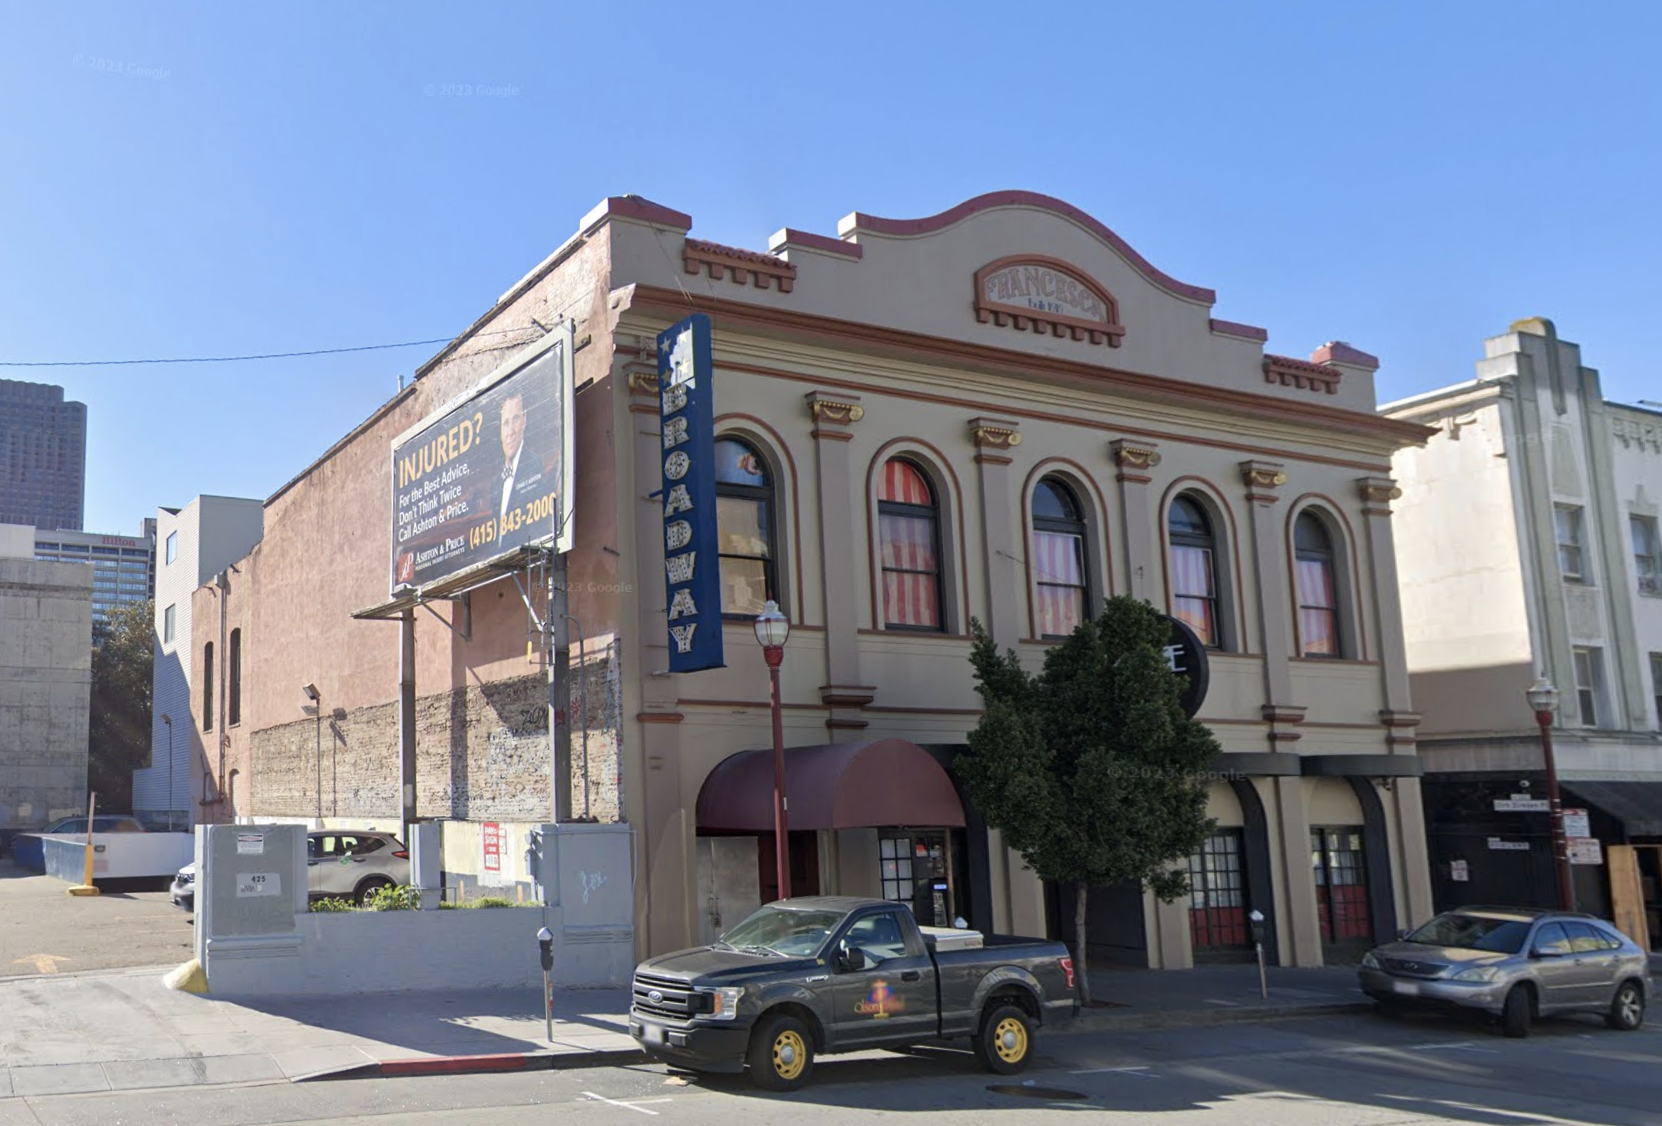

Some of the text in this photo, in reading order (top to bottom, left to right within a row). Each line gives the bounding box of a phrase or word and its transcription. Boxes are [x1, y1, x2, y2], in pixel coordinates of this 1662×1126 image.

[399, 412, 483, 488] INJURED?
[399, 463, 470, 509] For the Best Advice,
[399, 485, 462, 526] Don't Think Twice
[399, 501, 469, 542] Call Ashton & Price.
[469, 518, 497, 550] (415)
[661, 382, 698, 654] BROADWAY
[102, 536, 135, 547] Hilton
[415, 535, 465, 565] ASHTON & PRICE
[251, 875, 266, 883] 425
